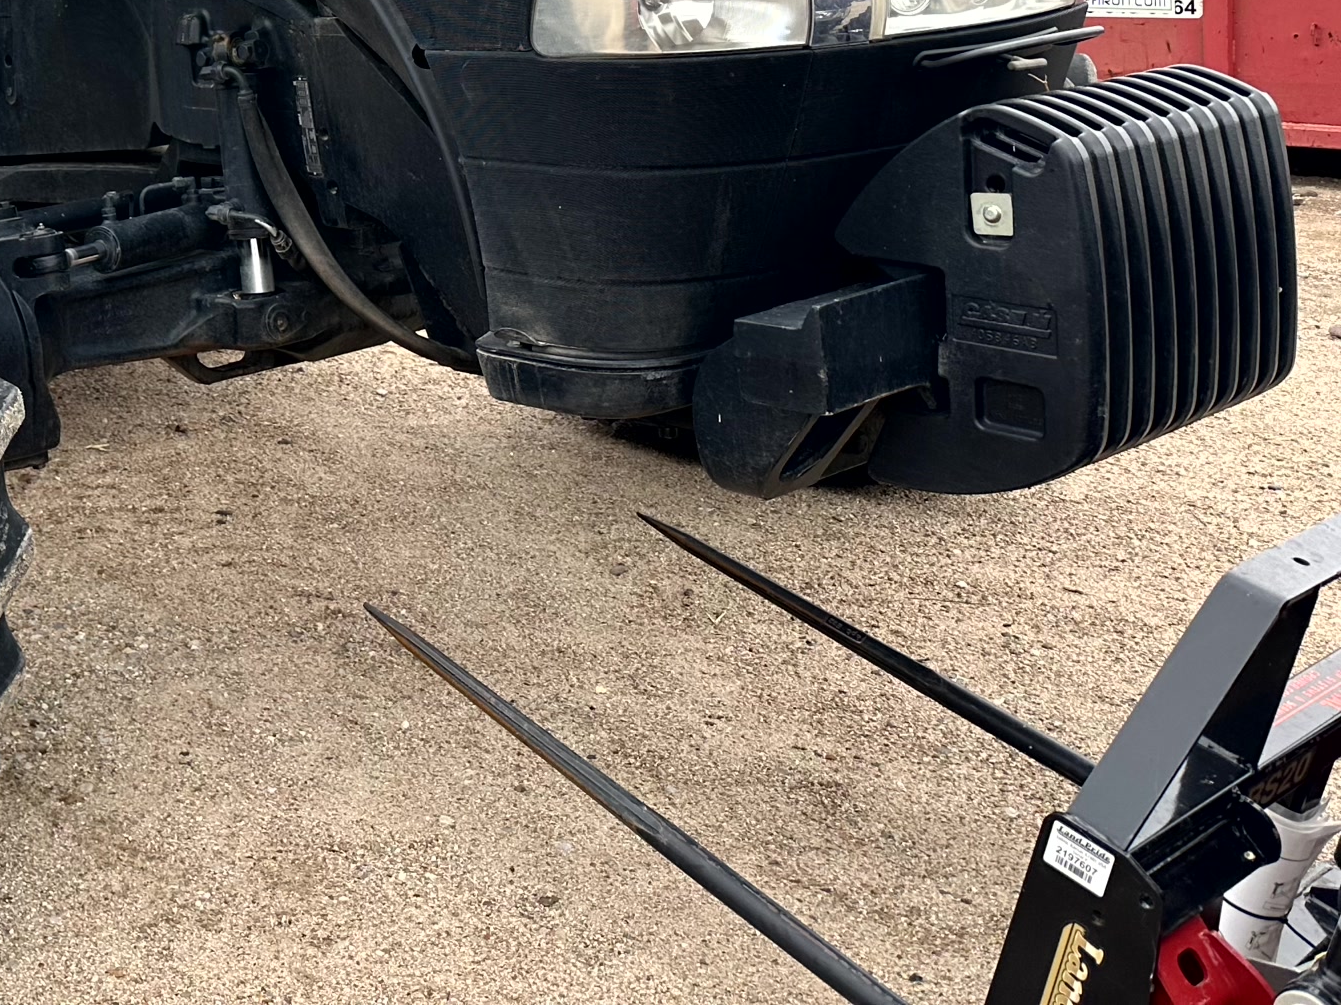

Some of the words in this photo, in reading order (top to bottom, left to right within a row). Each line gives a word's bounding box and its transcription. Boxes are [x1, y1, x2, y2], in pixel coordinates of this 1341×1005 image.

[1055, 845, 1098, 876] 2197607
[1056, 825, 1083, 847] Land
[1085, 841, 1111, 863] Pride
[1054, 928, 1104, 1005] Lan
